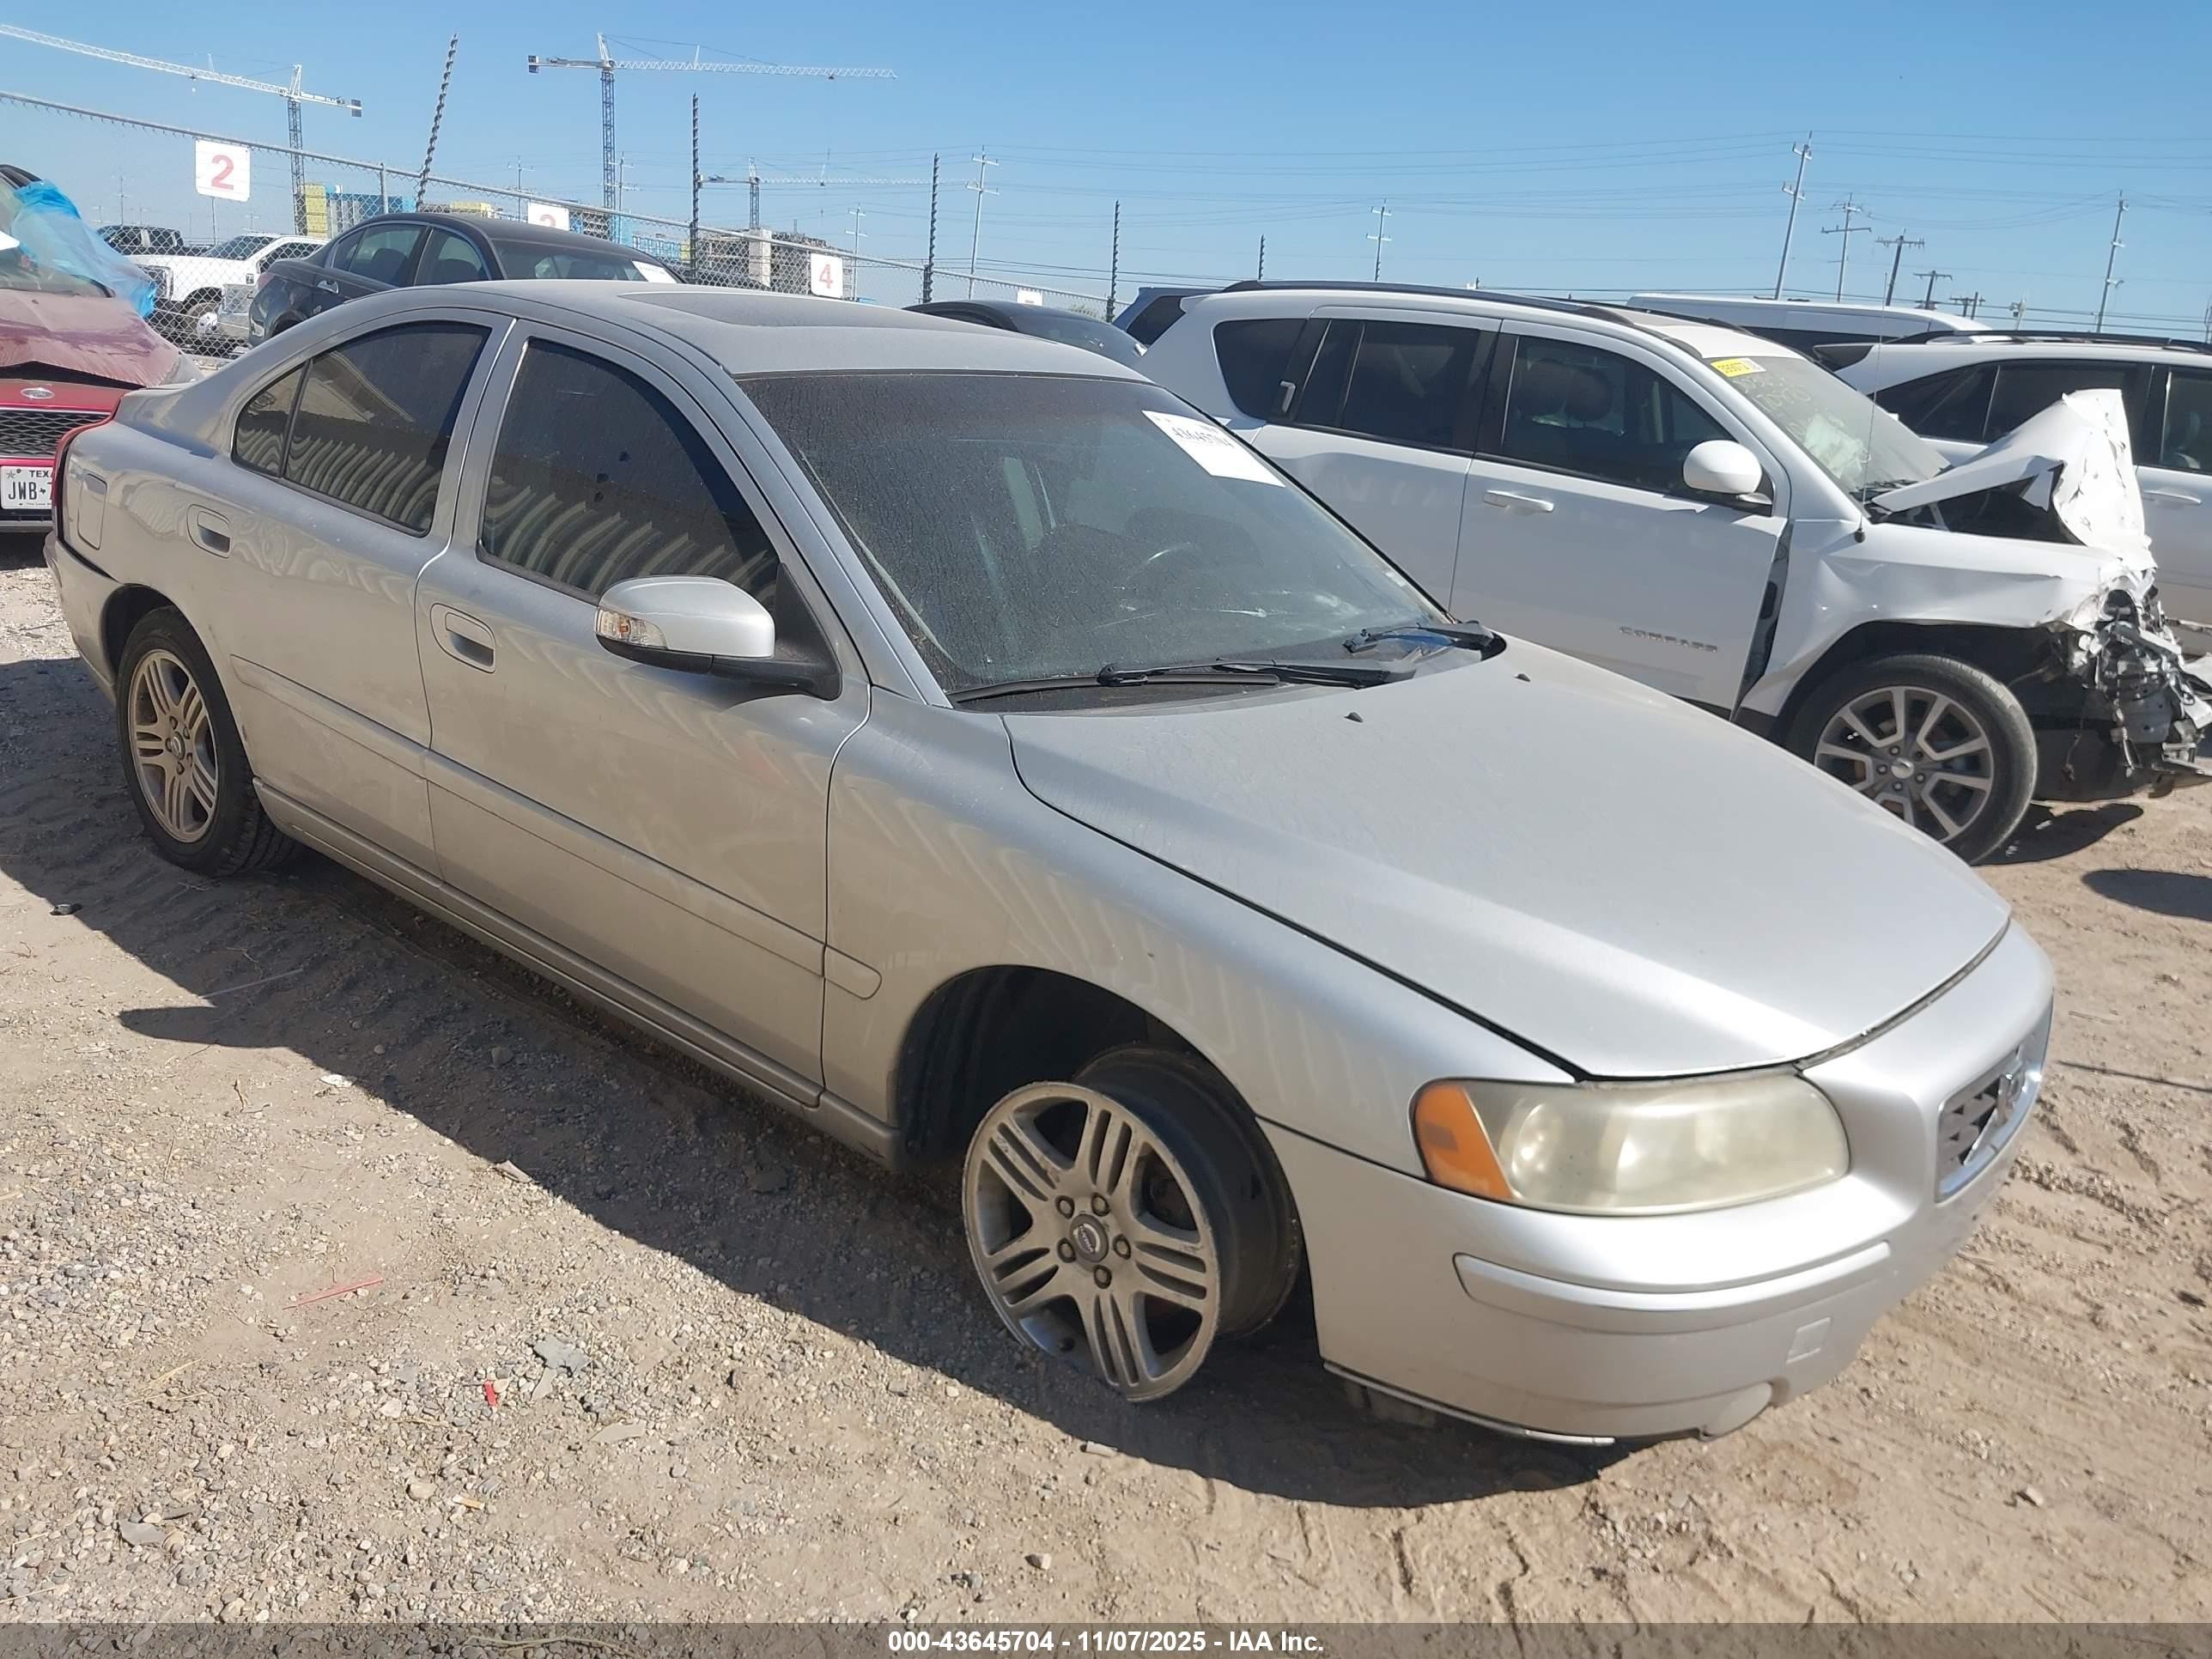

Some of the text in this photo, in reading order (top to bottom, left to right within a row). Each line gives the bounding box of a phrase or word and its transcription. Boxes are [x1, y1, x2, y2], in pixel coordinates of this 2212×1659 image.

[210, 154, 234, 191] 2
[818, 264, 834, 289] 4
[28, 470, 52, 478] TEX
